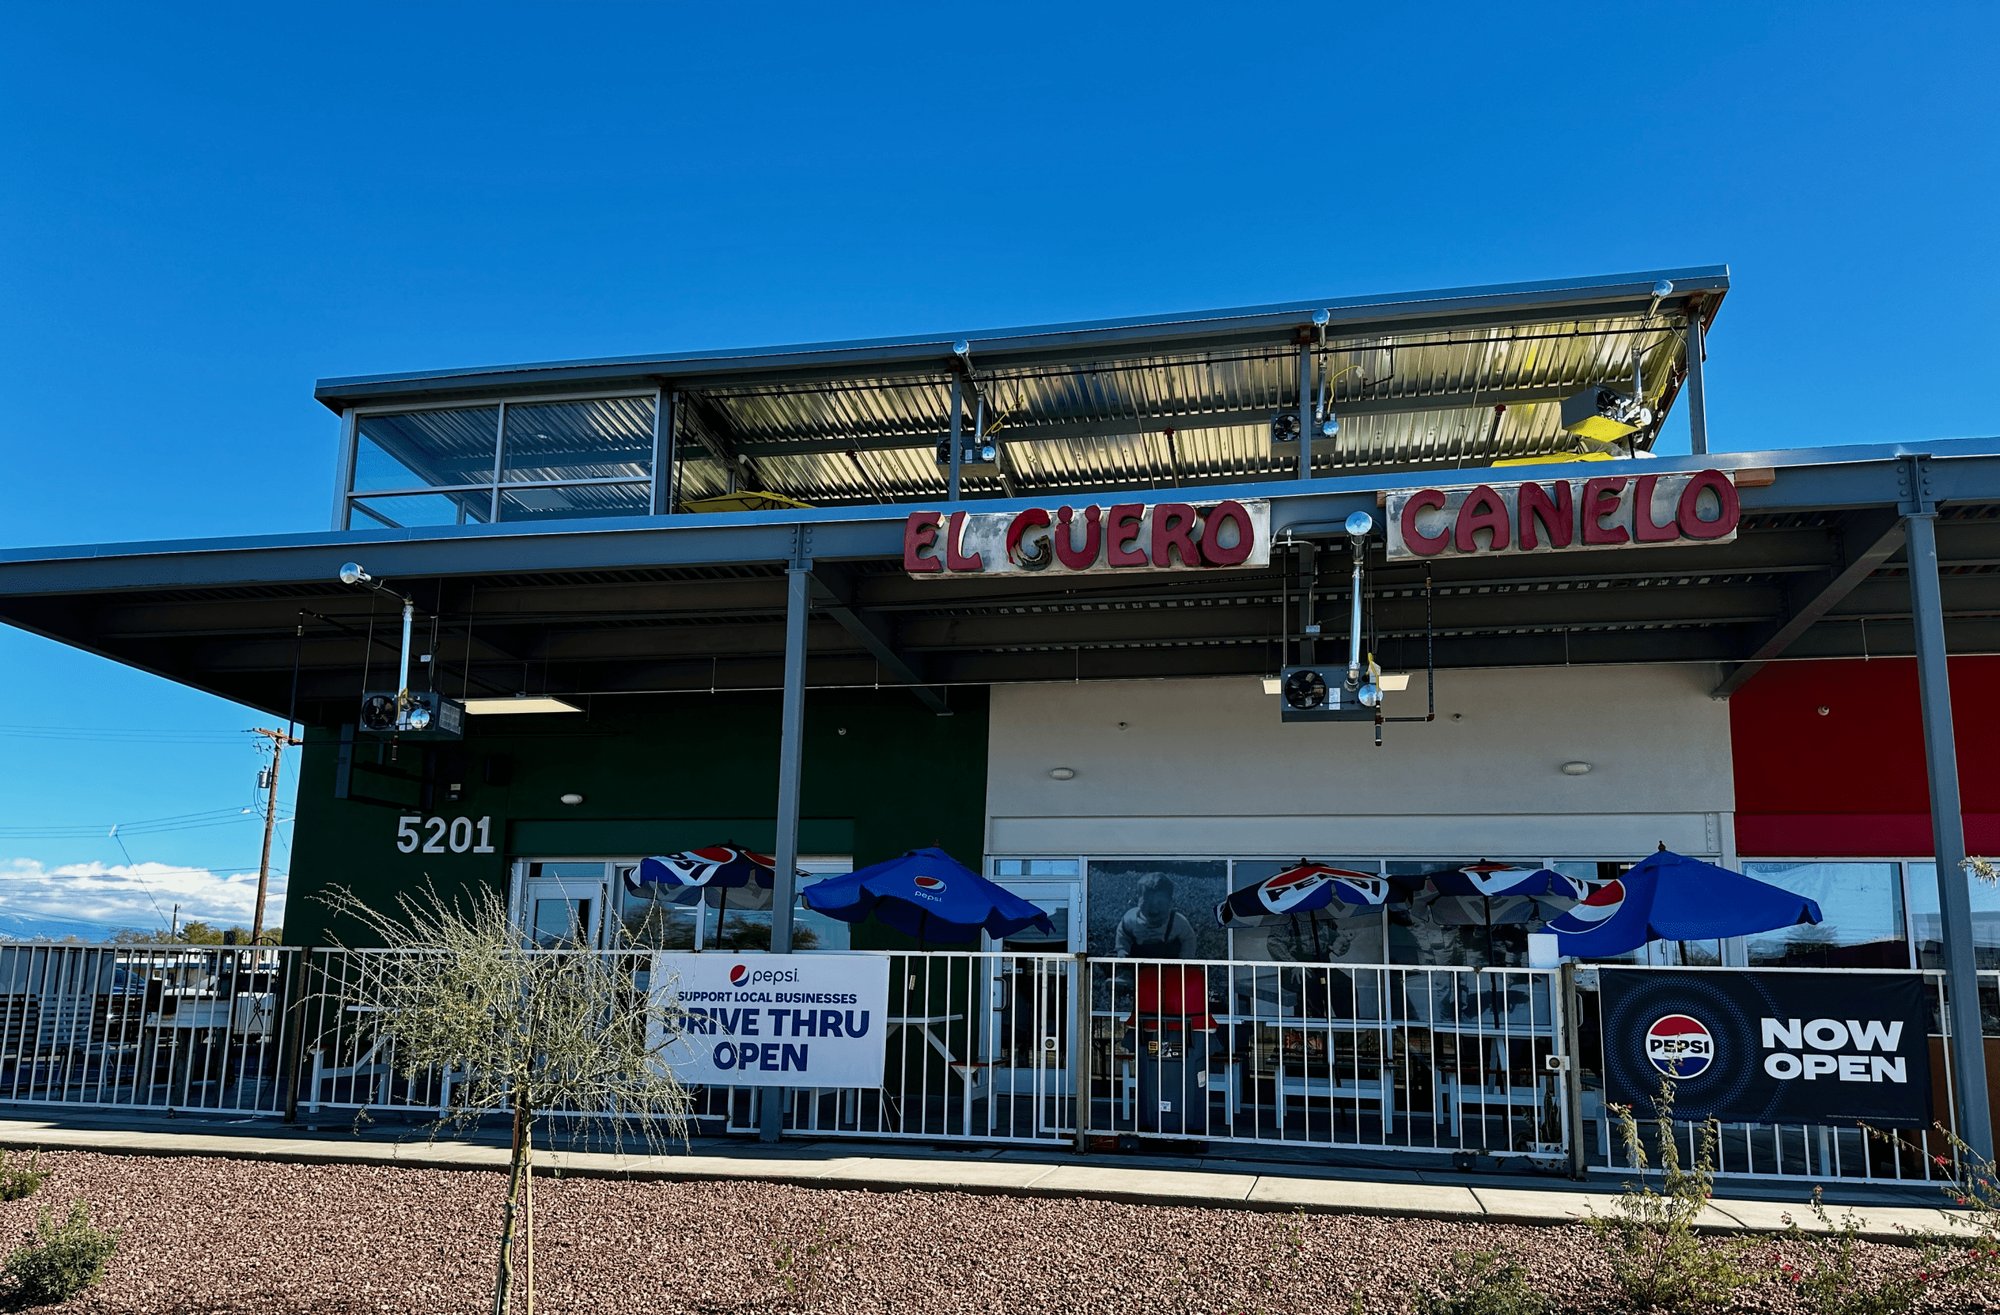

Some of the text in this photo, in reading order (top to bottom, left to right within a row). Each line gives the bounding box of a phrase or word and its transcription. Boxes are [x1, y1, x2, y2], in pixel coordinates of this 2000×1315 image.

[904, 511, 984, 572] EL
[1401, 469, 1740, 556] CANELO
[396, 816, 494, 854] 5201
[914, 890, 942, 902] pepsi
[752, 968, 799, 985] pepsi
[678, 991, 857, 1005] SUPPORT LOCAL BUSINESSES
[768, 1009, 870, 1038] THRU
[1761, 1018, 1904, 1052] NOW
[713, 1041, 808, 1072] OPEN
[1649, 1039, 1710, 1054] PEPSI
[1764, 1053, 1908, 1083] OPEN
